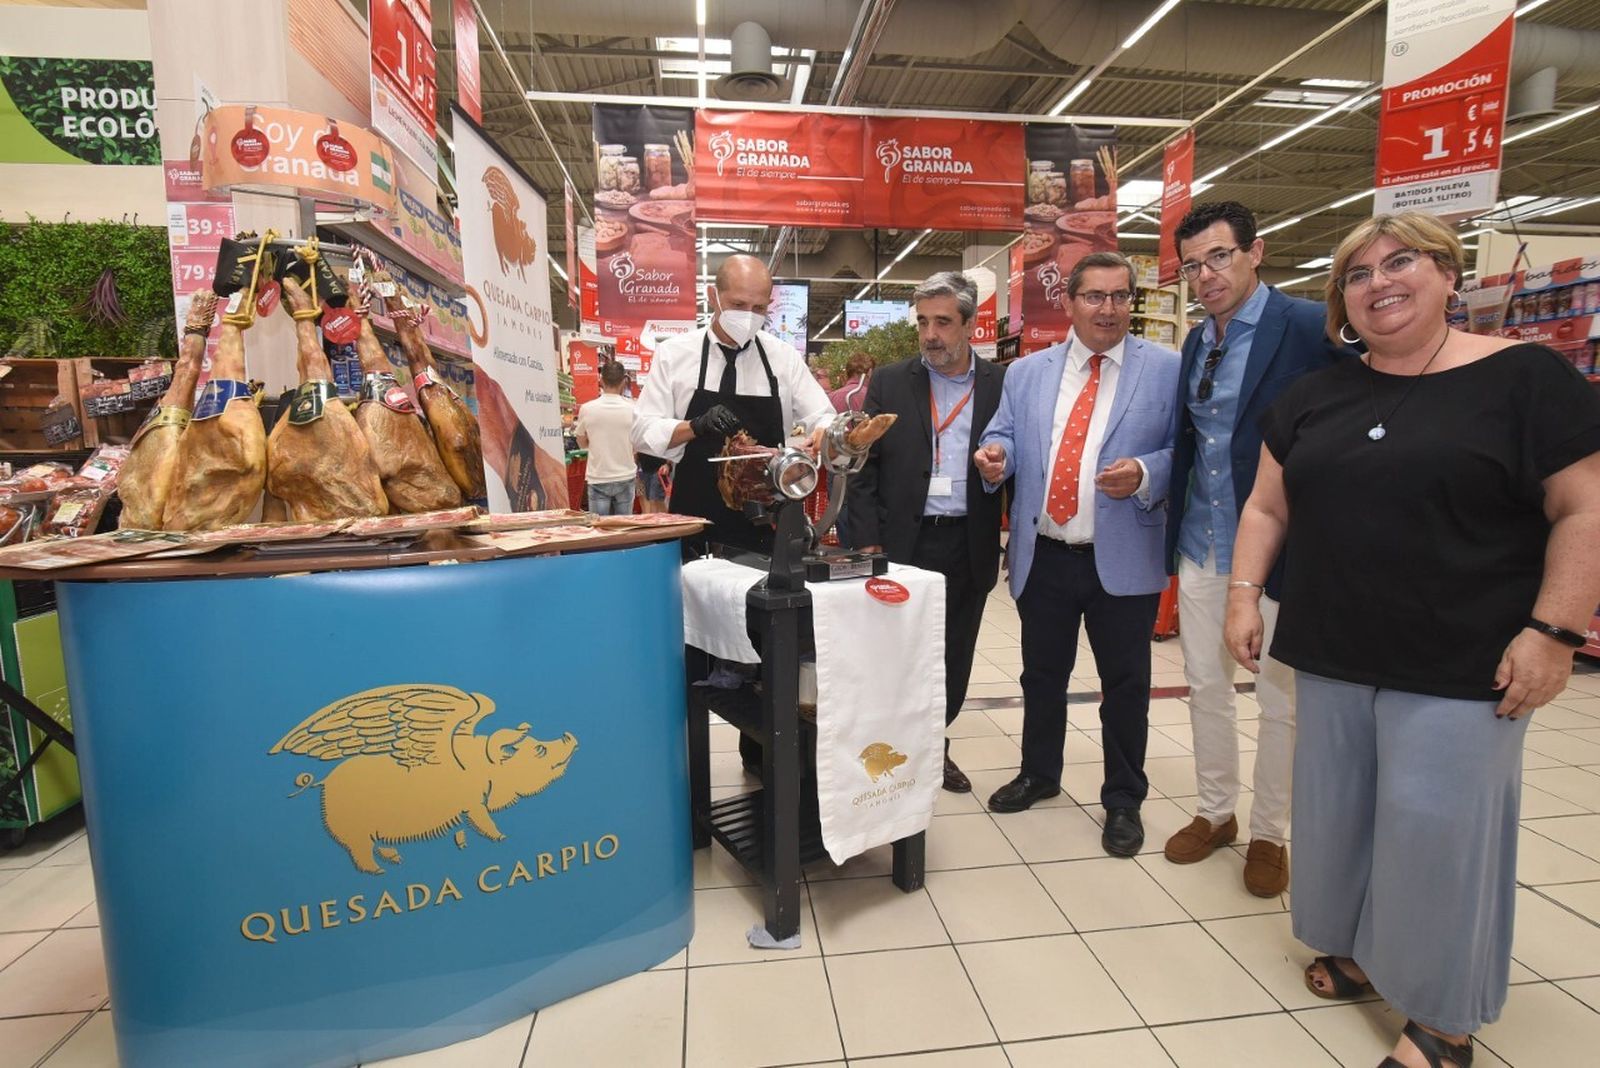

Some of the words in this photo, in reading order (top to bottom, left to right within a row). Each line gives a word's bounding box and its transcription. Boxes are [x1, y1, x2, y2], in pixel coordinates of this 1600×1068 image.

[1402, 73, 1493, 102] PROMOCIÓN
[61, 87, 157, 110] PRODU
[63, 111, 155, 138] ECOLÓ
[737, 139, 788, 152] SABOR
[1422, 127, 1450, 160] 1
[737, 153, 811, 168] GRANADA
[902, 146, 953, 160] SABOR
[747, 168, 759, 178] de
[760, 168, 797, 179] siempre
[902, 160, 974, 174] GRANADA
[913, 175, 924, 184] de
[926, 175, 960, 185] siempre
[1395, 187, 1433, 198] BATIDOS
[1435, 181, 1471, 192] PULEVA
[188, 218, 212, 235] 39
[181, 264, 205, 280] 79
[635, 268, 674, 281] Sabor
[624, 282, 680, 294] Granada
[483, 279, 523, 315] QUESADA
[524, 301, 551, 326] CARPIO
[240, 877, 464, 943] QUESADA
[477, 834, 620, 893] CARPIO
